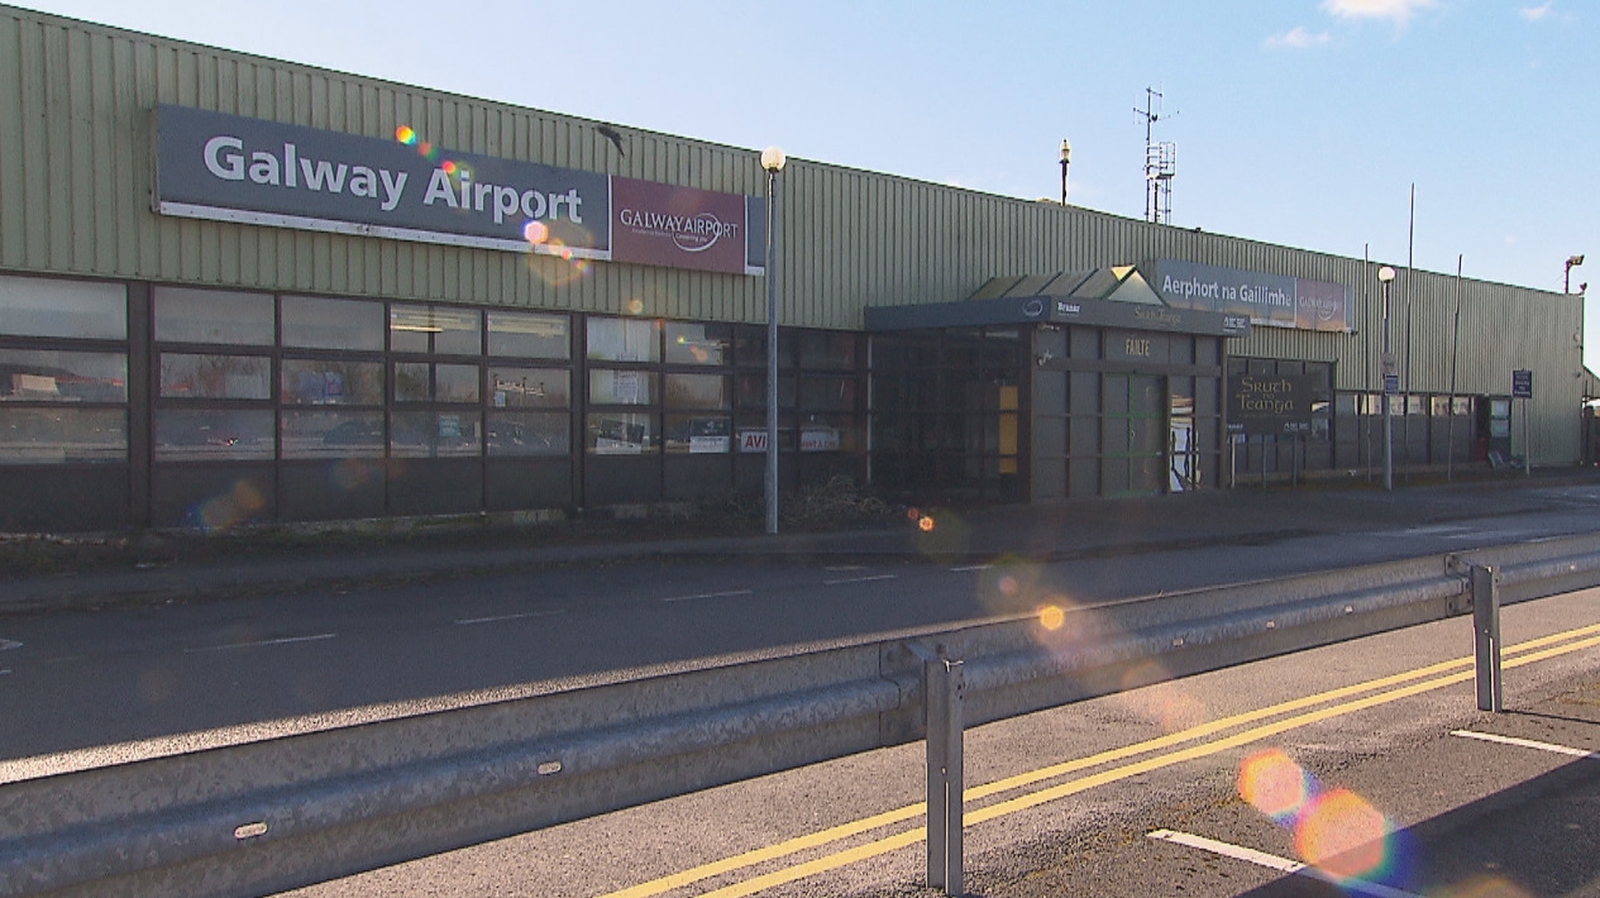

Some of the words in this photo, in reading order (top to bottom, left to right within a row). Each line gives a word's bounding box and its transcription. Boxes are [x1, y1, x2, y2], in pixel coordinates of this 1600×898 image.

[203, 135, 409, 211] Galway
[423, 167, 583, 224] Airport
[620, 209, 684, 231] GALWAY
[684, 216, 739, 239] AIRPORT
[1162, 275, 1219, 299] Aerphort
[1222, 286, 1236, 301] na
[1239, 285, 1292, 307] Gaillimhe
[1235, 393, 1294, 414] Teanga
[745, 434, 767, 448] AVI
